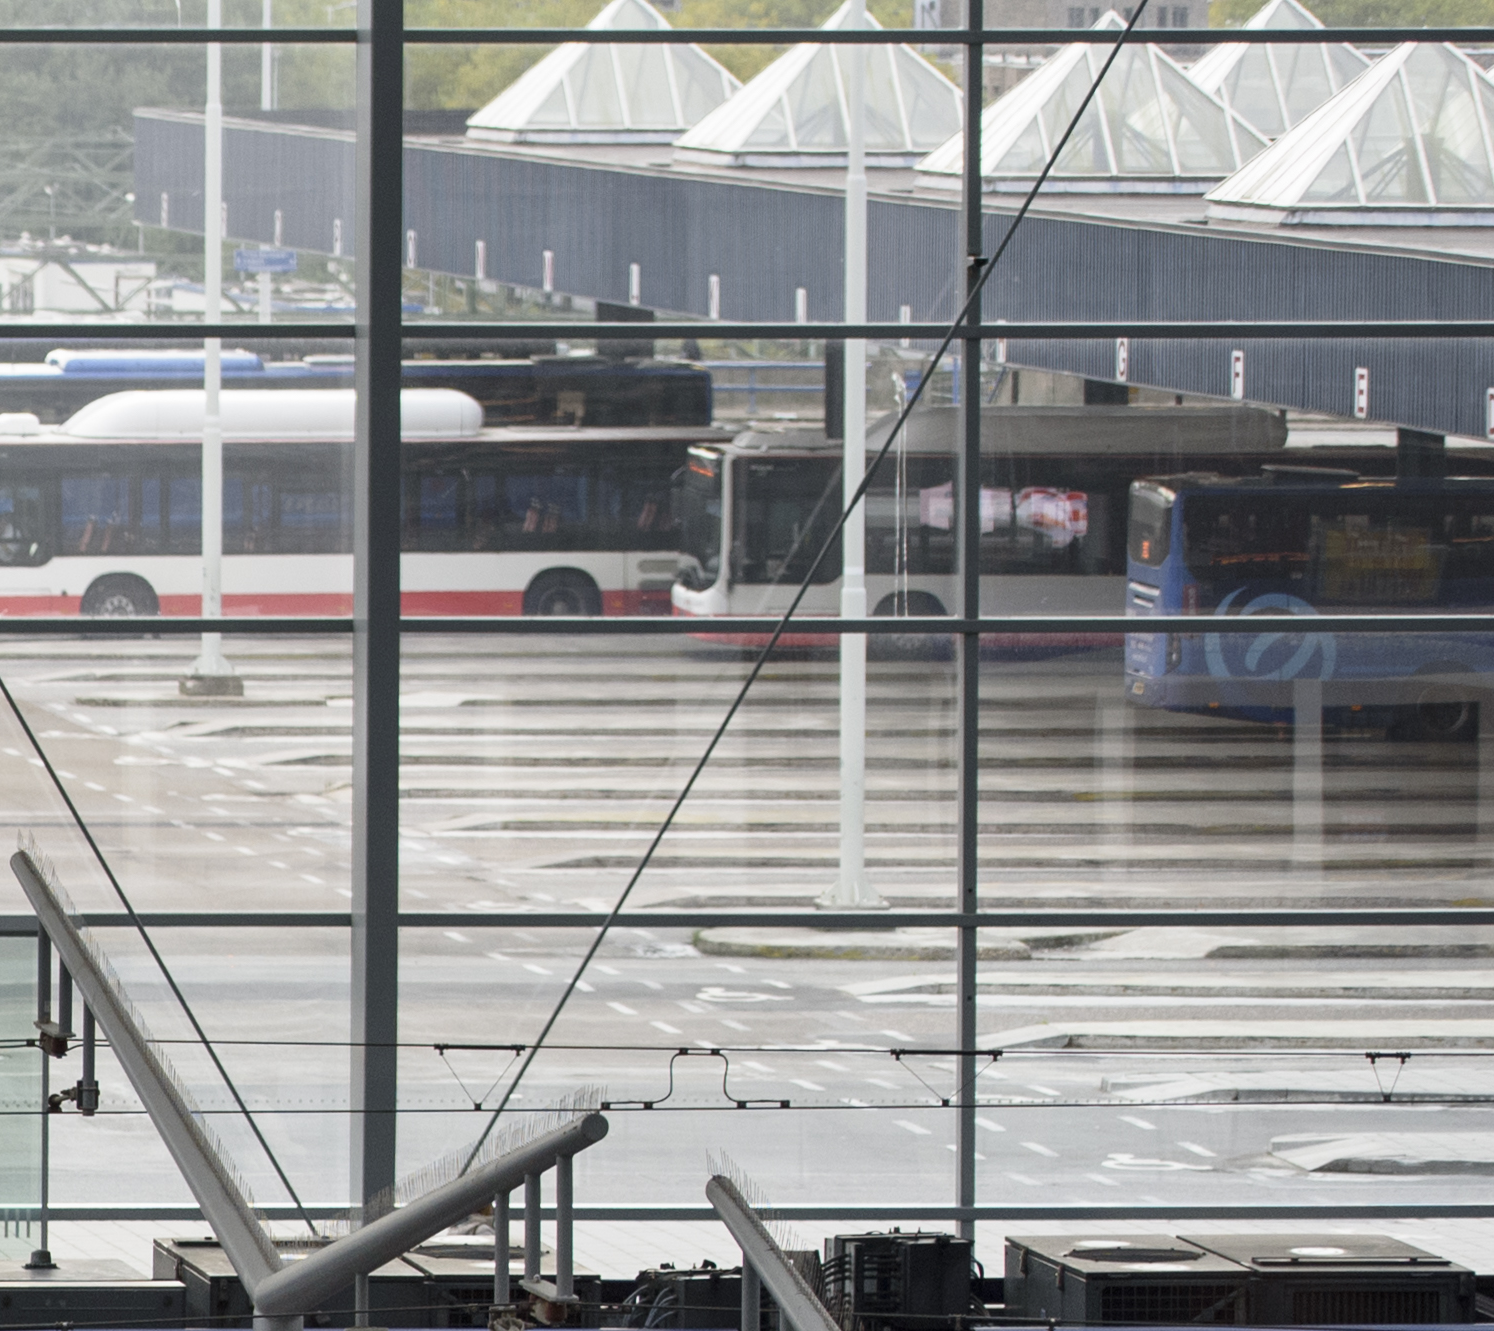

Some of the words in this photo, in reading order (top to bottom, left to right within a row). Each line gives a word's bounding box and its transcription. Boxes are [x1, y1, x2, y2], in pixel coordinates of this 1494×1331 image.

[1118, 340, 1126, 377] G
[1233, 355, 1242, 396] F
[1358, 373, 1366, 414] E
